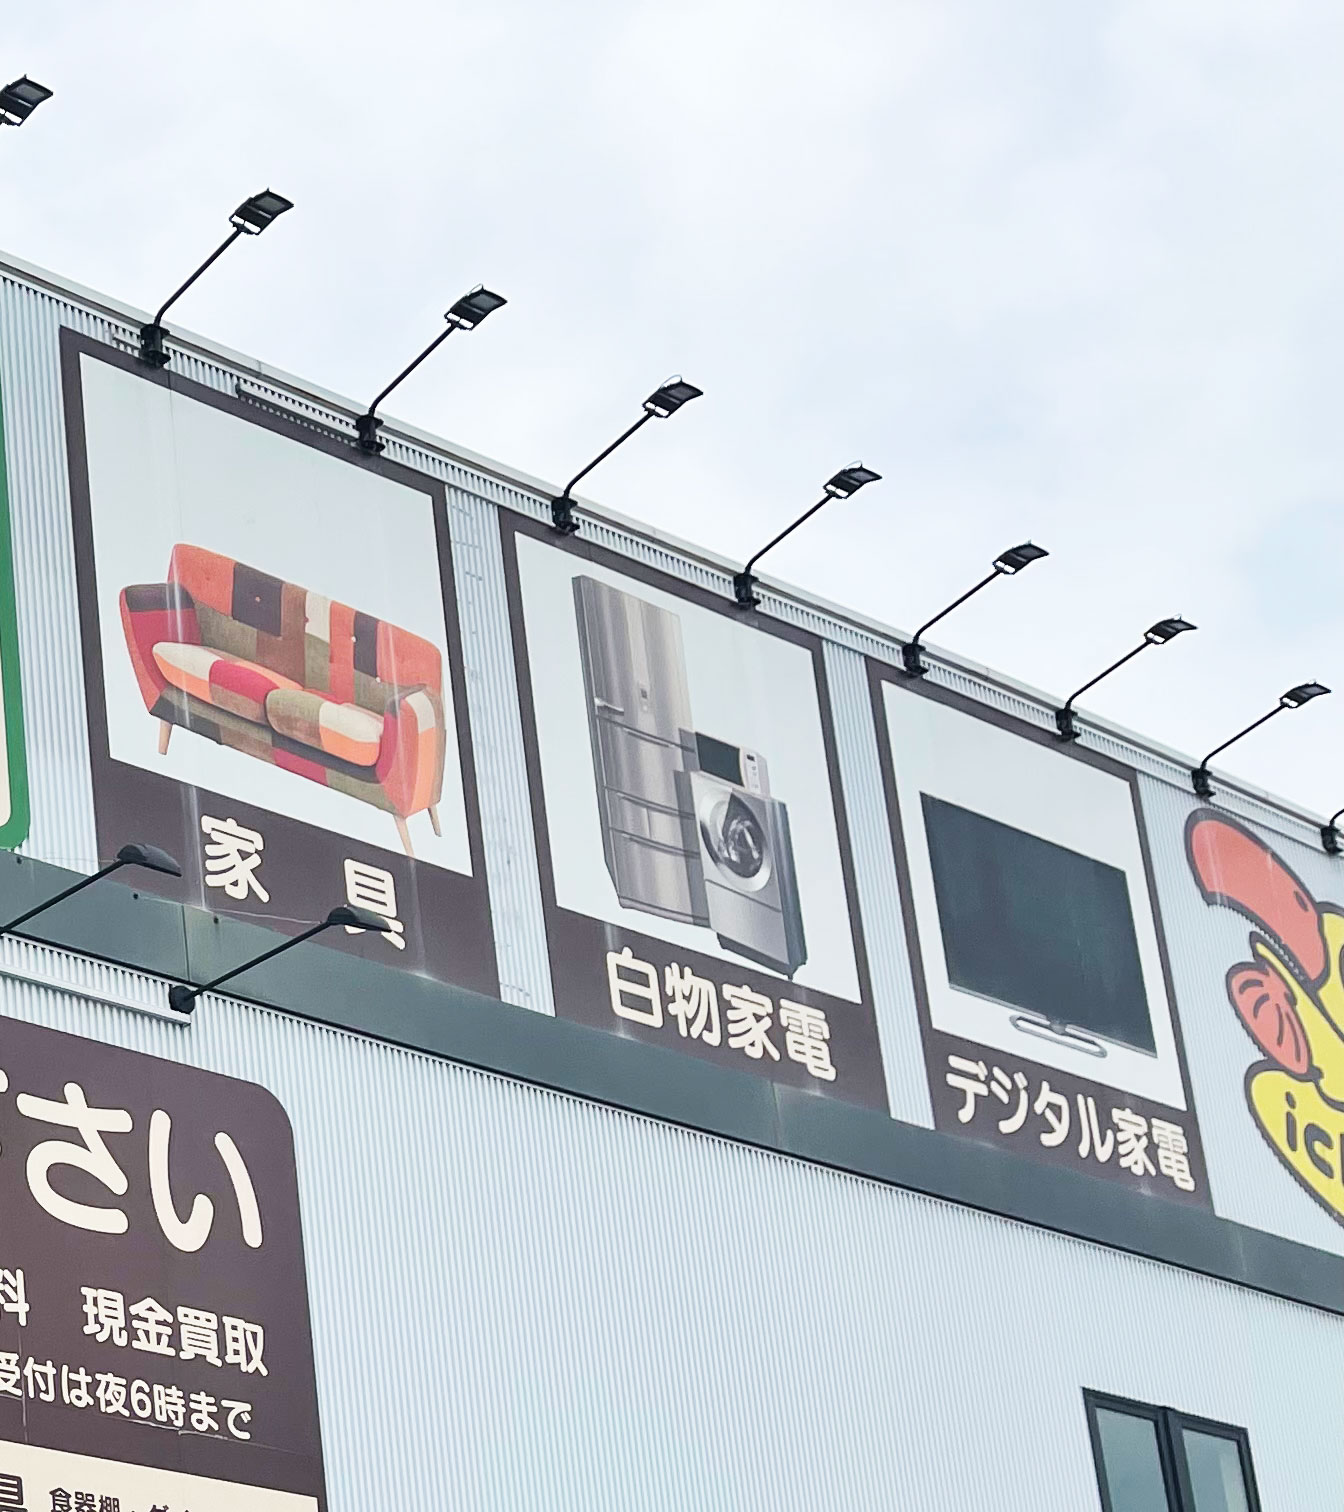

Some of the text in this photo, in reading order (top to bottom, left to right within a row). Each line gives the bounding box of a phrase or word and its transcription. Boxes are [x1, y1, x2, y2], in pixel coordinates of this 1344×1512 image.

[200, 814, 407, 951] 家具
[607, 947, 837, 1083] 白物家電
[946, 1054, 1196, 1193] デジタル家電
[80, 1286, 268, 1377] 現金買取
